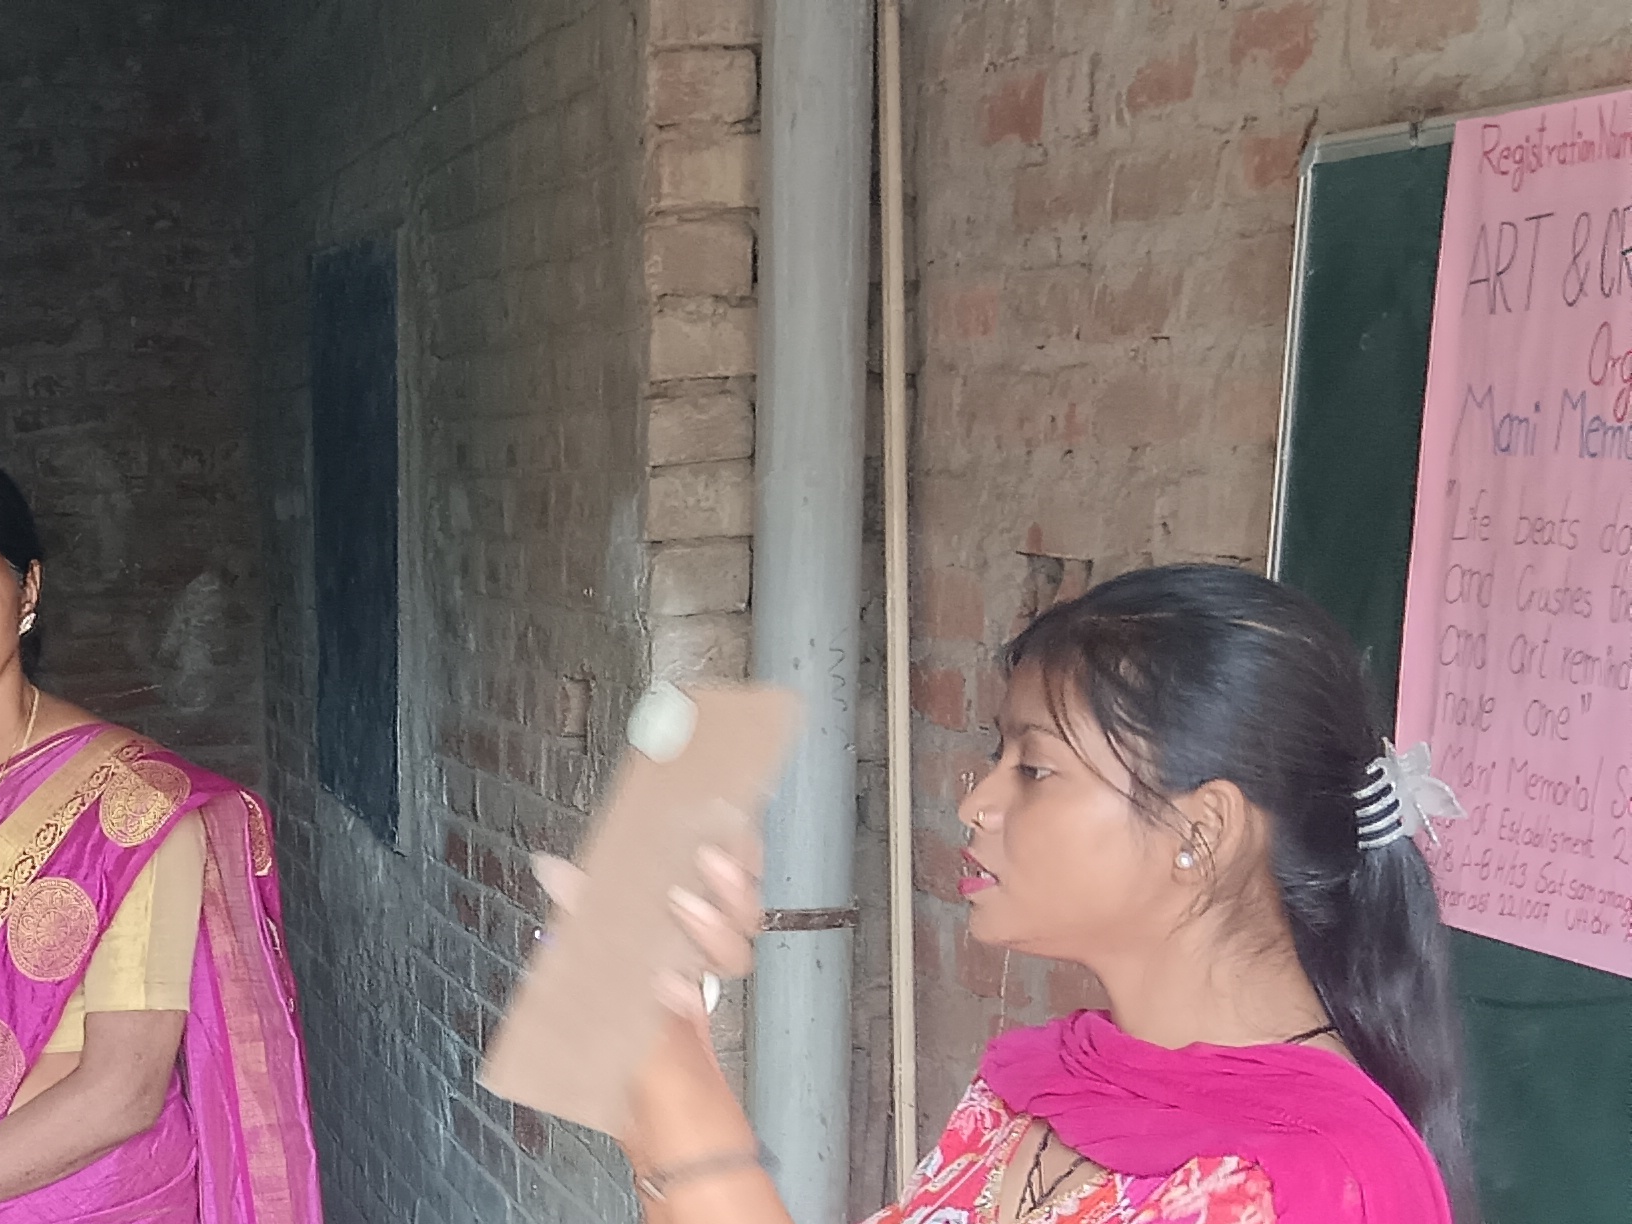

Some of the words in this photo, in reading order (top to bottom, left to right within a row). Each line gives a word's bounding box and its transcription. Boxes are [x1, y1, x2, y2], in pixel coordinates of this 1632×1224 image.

[1480, 106, 1595, 192] Registration
[1462, 212, 1555, 315] ART
[1563, 211, 1591, 307] &
[1450, 383, 1542, 456] Mani
[1514, 488, 1581, 550] beats
[1506, 756, 1605, 815] Memorial
